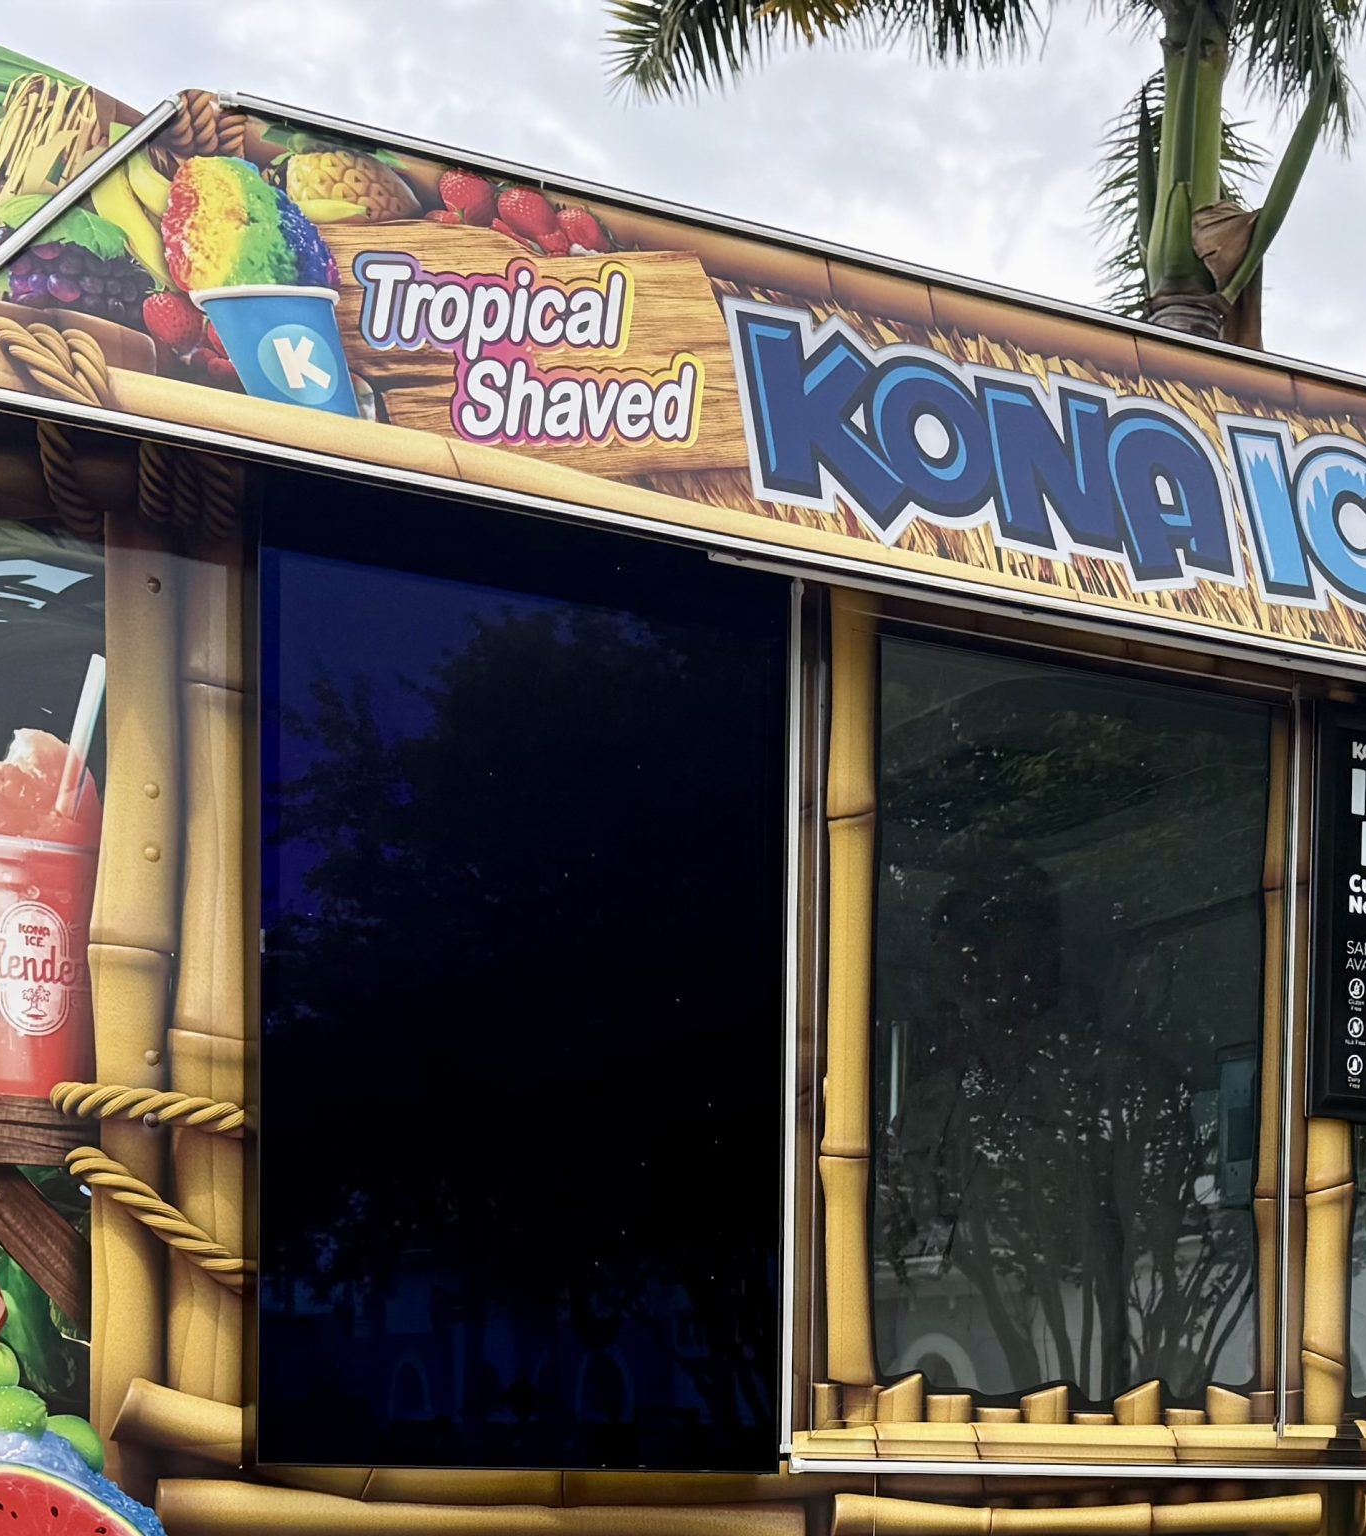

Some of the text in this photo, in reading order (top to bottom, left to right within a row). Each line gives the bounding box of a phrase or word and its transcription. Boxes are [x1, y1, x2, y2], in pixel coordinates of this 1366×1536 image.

[361, 258, 627, 358] Tropical
[274, 336, 332, 391] K
[457, 353, 697, 442] Shaved
[731, 304, 1239, 586] KONA
[18, 922, 51, 937] KONA
[24, 935, 45, 947] ICE
